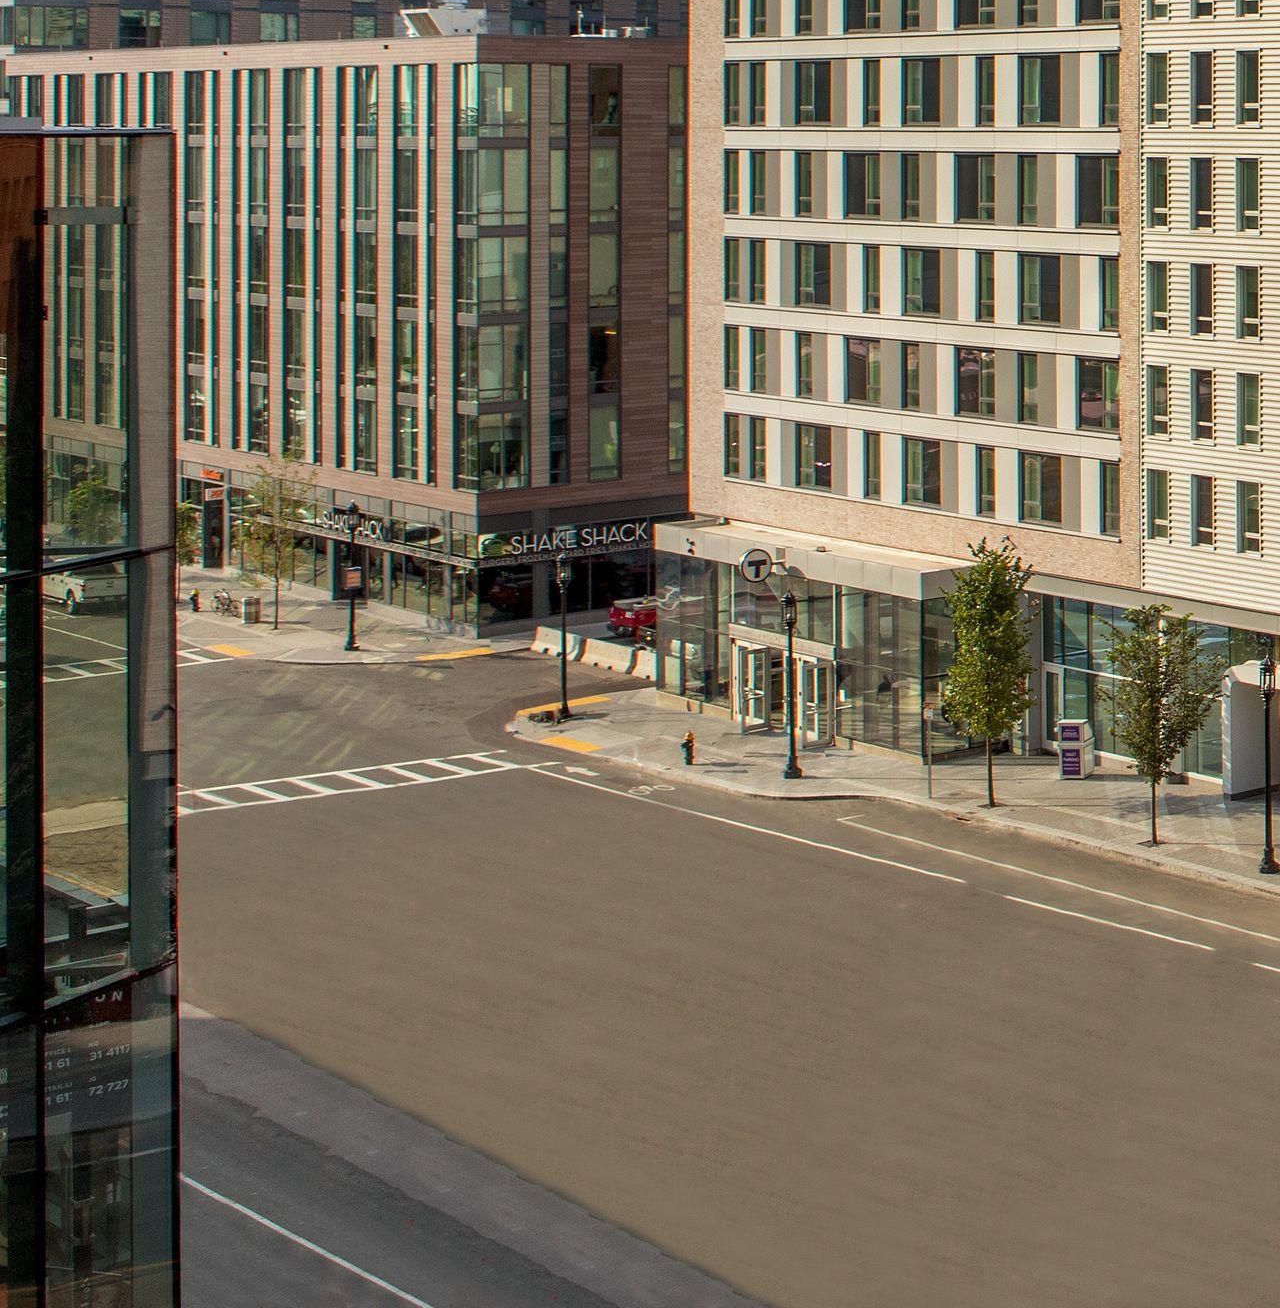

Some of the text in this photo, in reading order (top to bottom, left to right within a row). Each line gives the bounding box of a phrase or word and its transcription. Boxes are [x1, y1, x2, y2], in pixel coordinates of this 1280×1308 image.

[510, 529, 578, 556] SHAKE
[581, 521, 648, 548] SHACK
[748, 558, 768, 578] T
